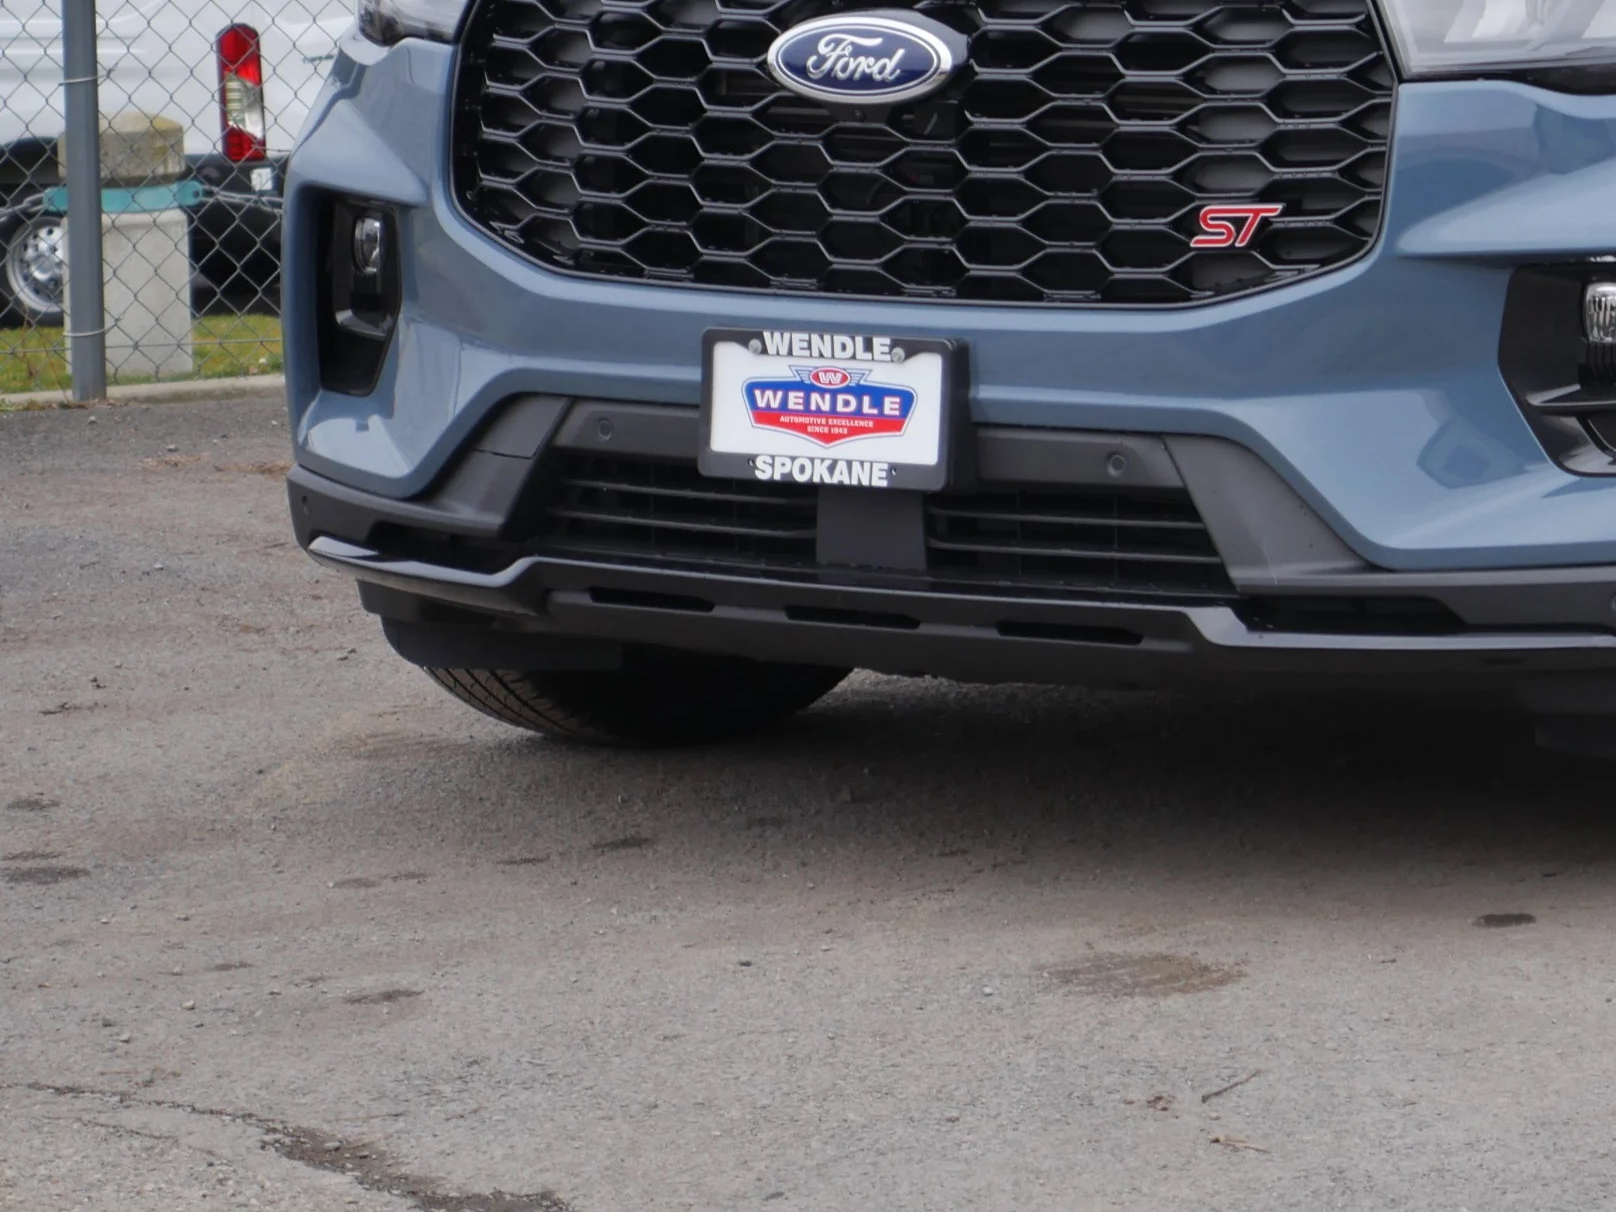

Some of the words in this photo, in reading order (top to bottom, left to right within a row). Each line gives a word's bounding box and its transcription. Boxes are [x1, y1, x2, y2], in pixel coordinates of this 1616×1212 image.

[806, 33, 905, 82] Ford
[1190, 203, 1285, 247] ST
[763, 331, 891, 362] WENDLE
[754, 389, 901, 416] WENDLE
[780, 415, 826, 426] AUTOMOTIVE
[828, 418, 874, 428] EXCELLENCE
[807, 425, 829, 434] SINCE
[830, 426, 848, 435] 1943
[754, 455, 888, 487] SPOKANE
